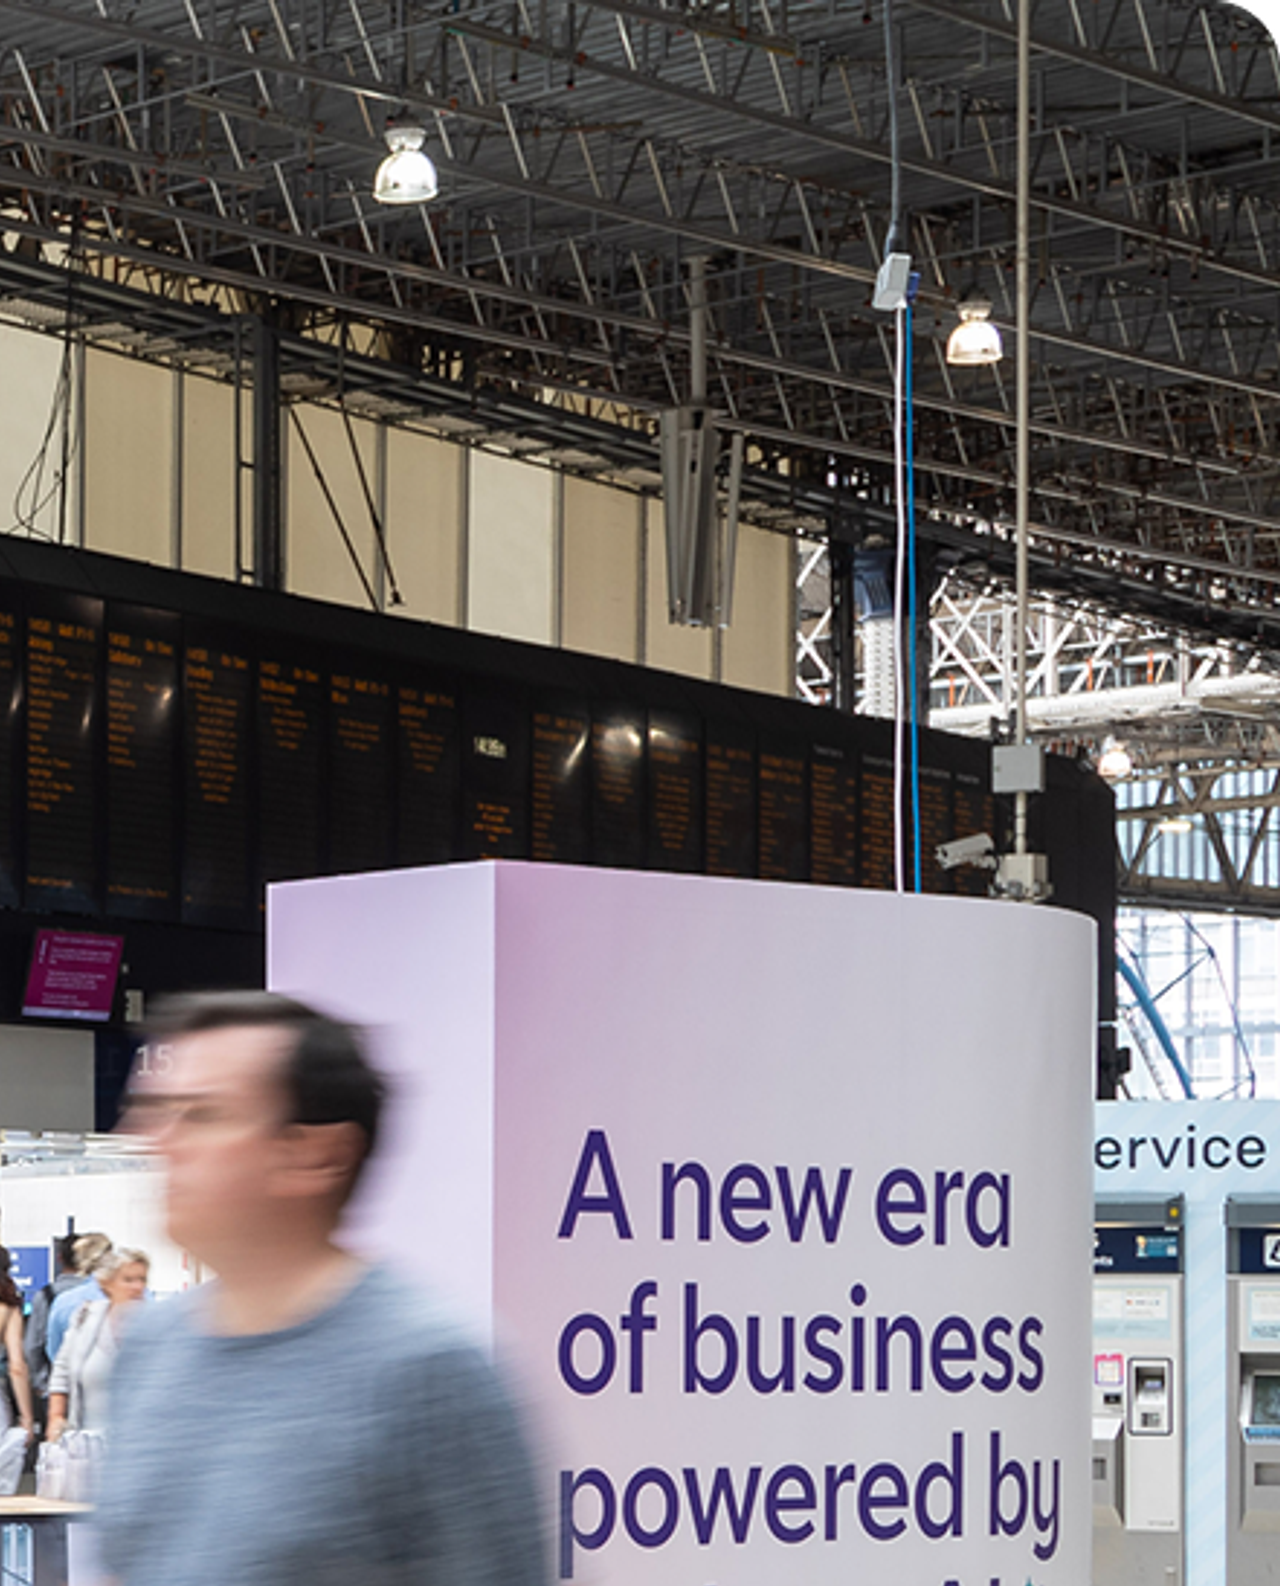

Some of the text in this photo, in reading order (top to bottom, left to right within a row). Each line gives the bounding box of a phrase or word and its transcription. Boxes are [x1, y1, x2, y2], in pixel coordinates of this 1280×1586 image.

[136, 1044, 173, 1076] 15
[557, 1129, 1010, 1248] A new era
[1094, 1123, 1267, 1170] ervice
[557, 1280, 1045, 1395] of business
[559, 1431, 1061, 1579] powered by
